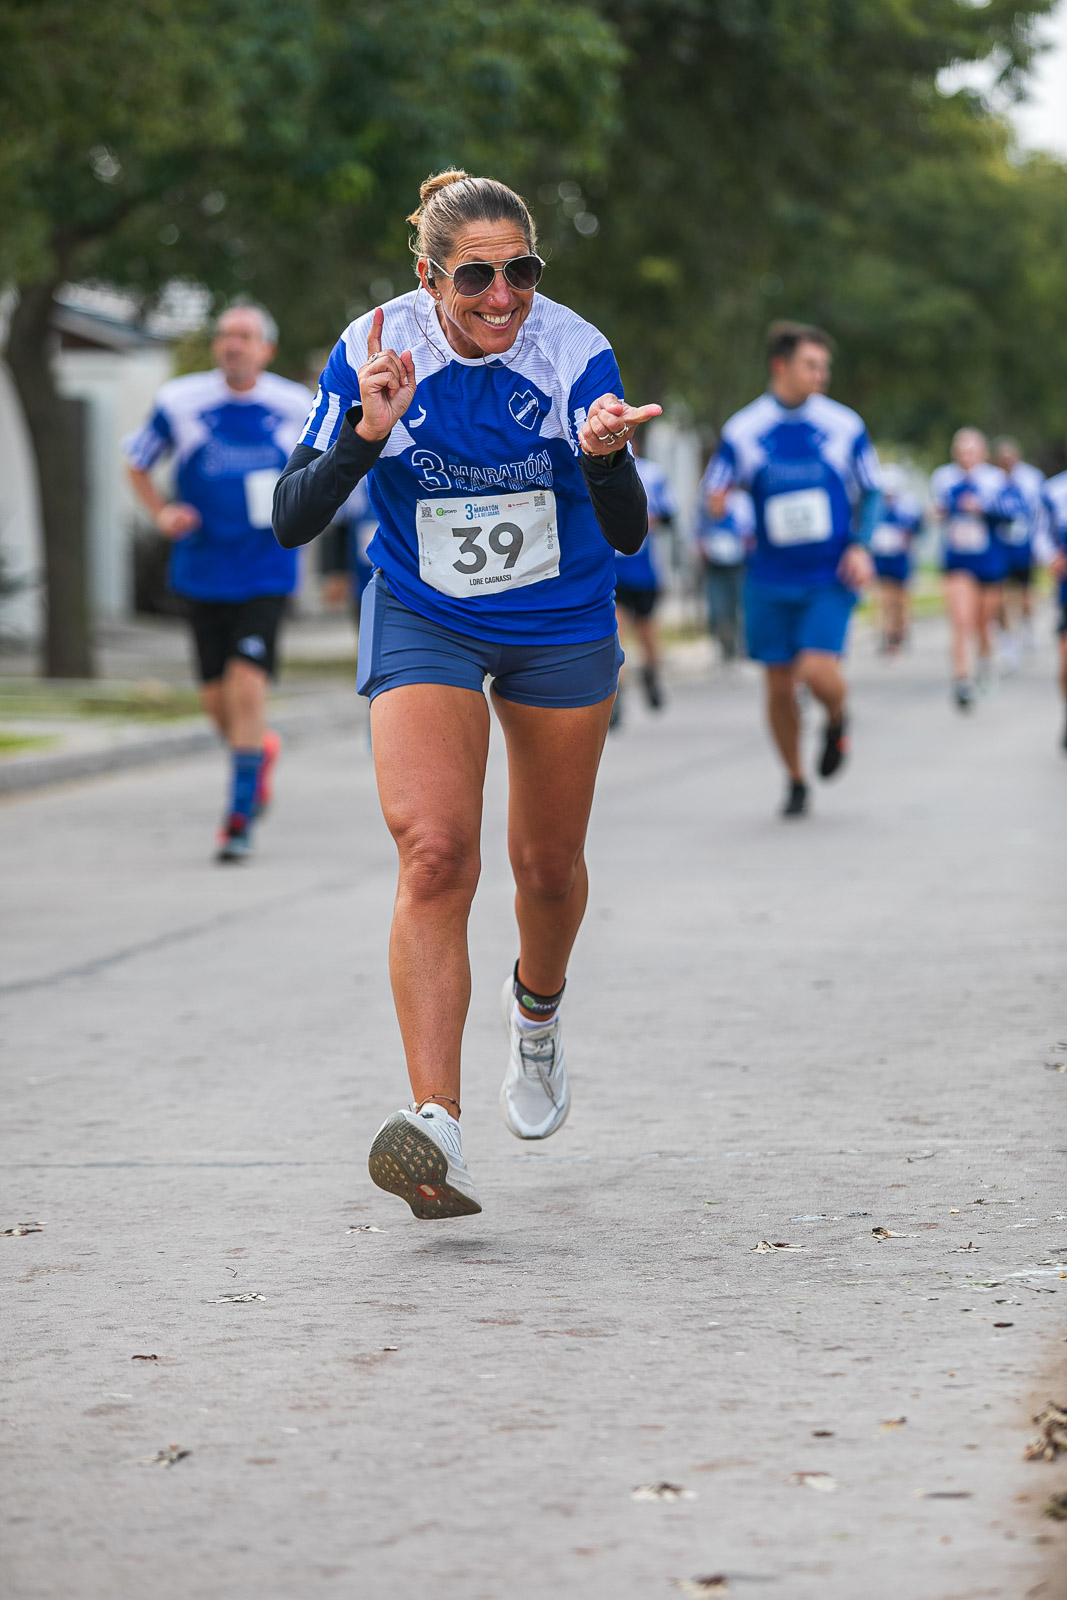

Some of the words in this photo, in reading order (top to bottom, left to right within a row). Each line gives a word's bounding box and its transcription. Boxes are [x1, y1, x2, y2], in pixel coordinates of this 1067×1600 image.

[411, 449, 452, 492] 3
[448, 449, 553, 483] MARATÓN
[465, 503, 474, 521] 3
[473, 504, 500, 514] MARATÓN
[452, 522, 524, 575] 39
[469, 578, 484, 586] LORE
[485, 574, 512, 584] CAGNASSI
